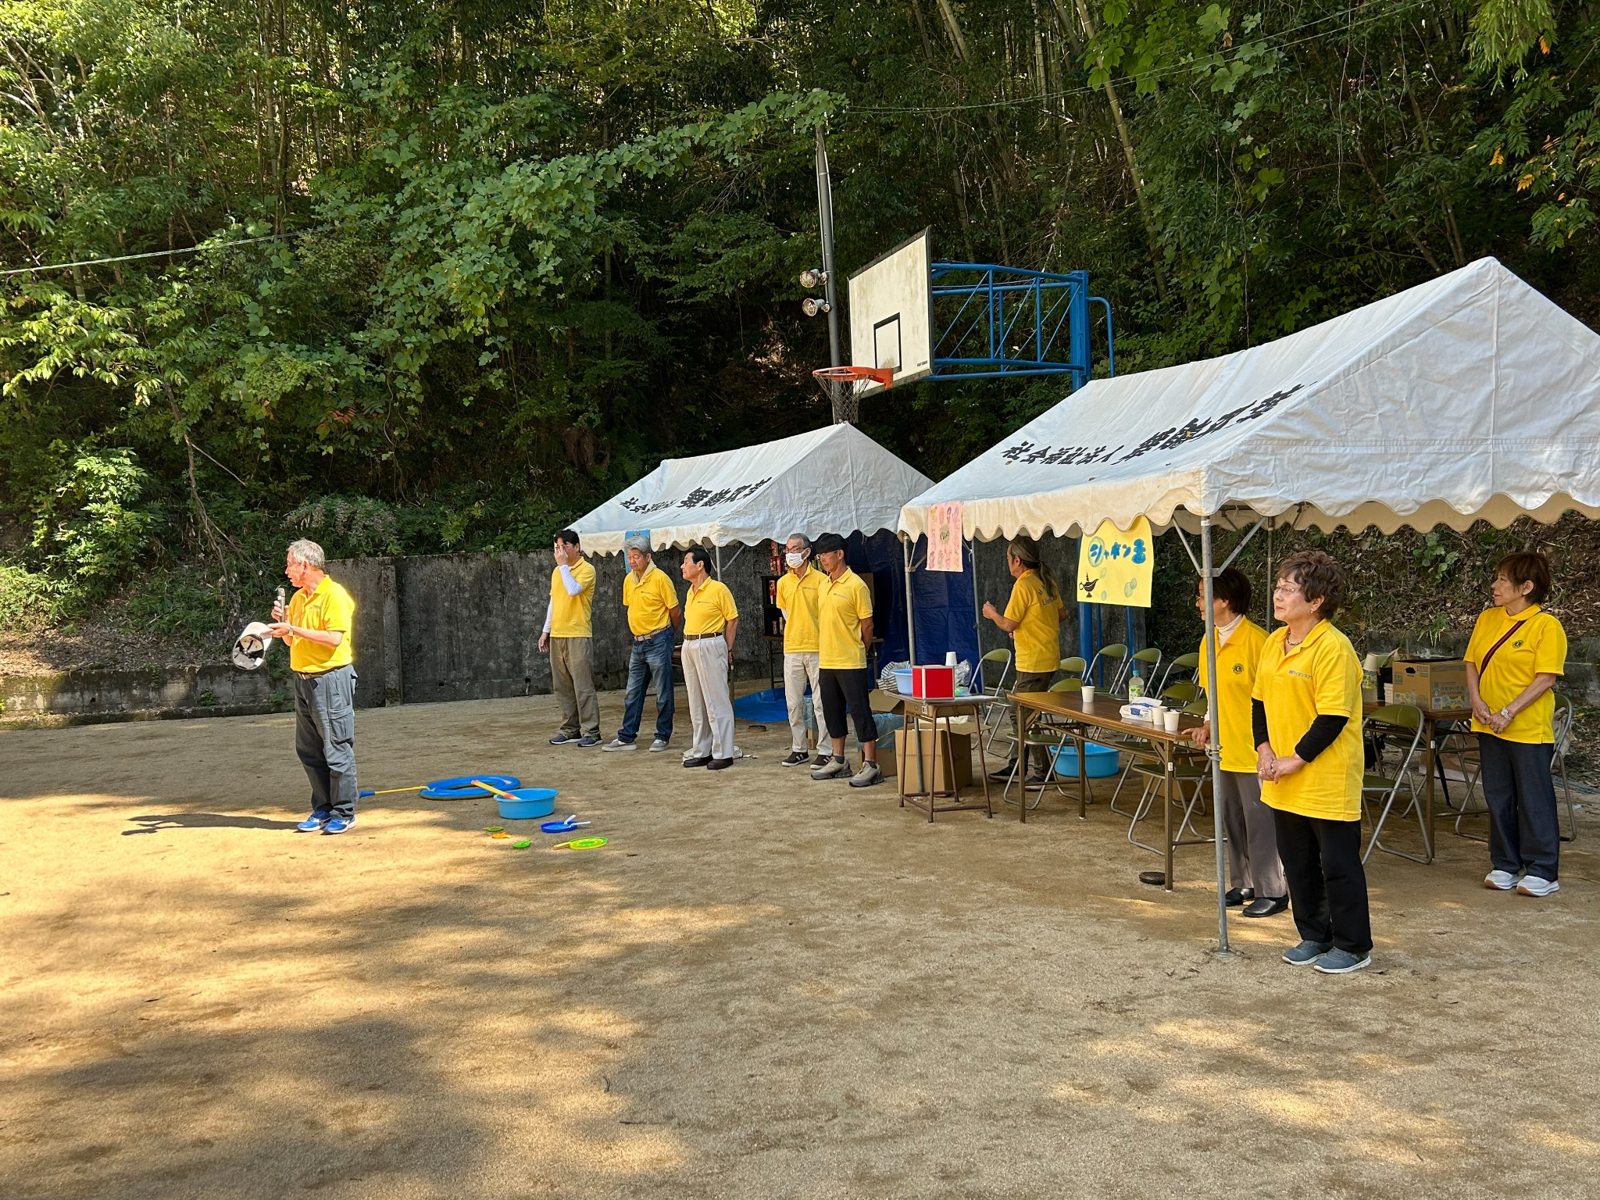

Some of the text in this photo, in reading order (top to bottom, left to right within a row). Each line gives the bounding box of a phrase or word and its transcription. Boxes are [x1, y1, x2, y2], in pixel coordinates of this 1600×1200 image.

[1001, 441, 1124, 465] 社会福祉法人
